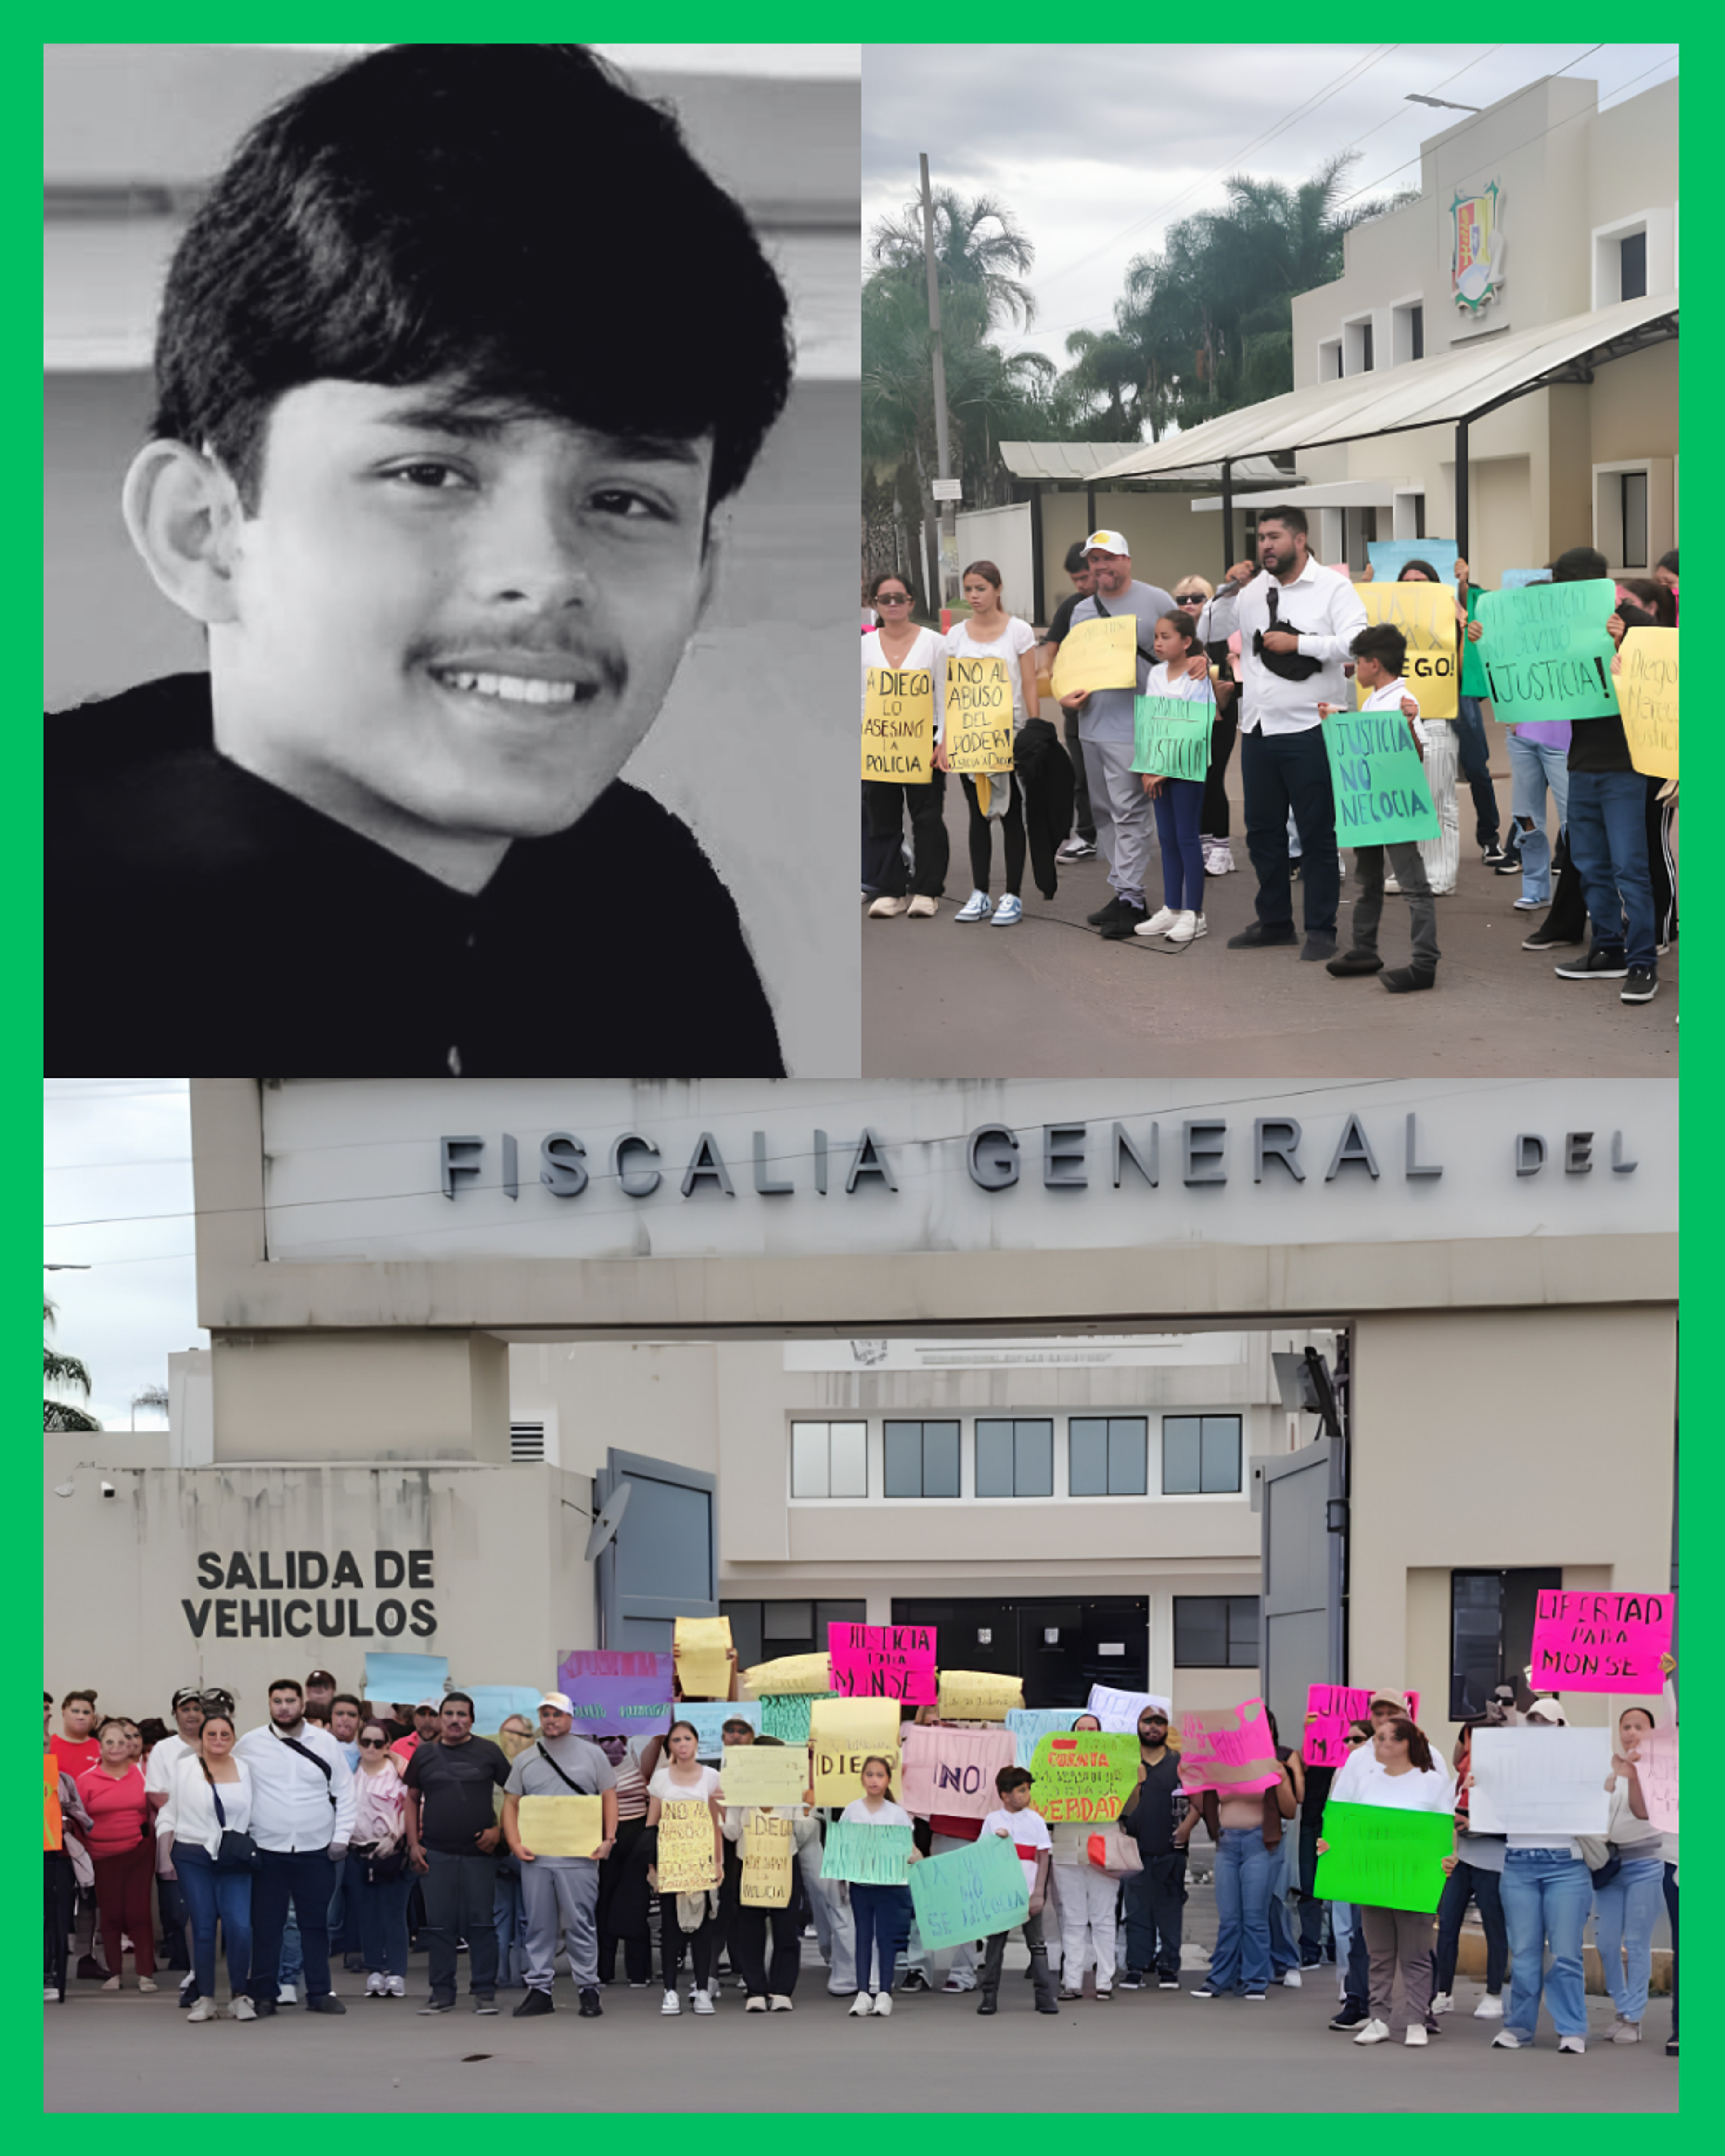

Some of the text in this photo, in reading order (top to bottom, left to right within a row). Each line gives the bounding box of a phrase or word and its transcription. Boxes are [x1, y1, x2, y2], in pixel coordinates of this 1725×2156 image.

[879, 670, 929, 696] DIEGO
[990, 662, 1008, 683] AL
[1485, 656, 1610, 703] ¡JUSTICIA!
[883, 699, 902, 716] LO
[947, 685, 1003, 711] ABUSO
[963, 711, 992, 729] DEL
[1335, 718, 1414, 757] JUSTICIA
[866, 755, 922, 773] POLICIA
[1339, 757, 1371, 792] NO
[440, 1112, 1638, 1201] FISCALIA GENERAL DEL
[197, 1550, 435, 1590] SALIDA DE
[181, 1599, 438, 1638] VEHICULOS
[1542, 1649, 1638, 1676] MONSE
